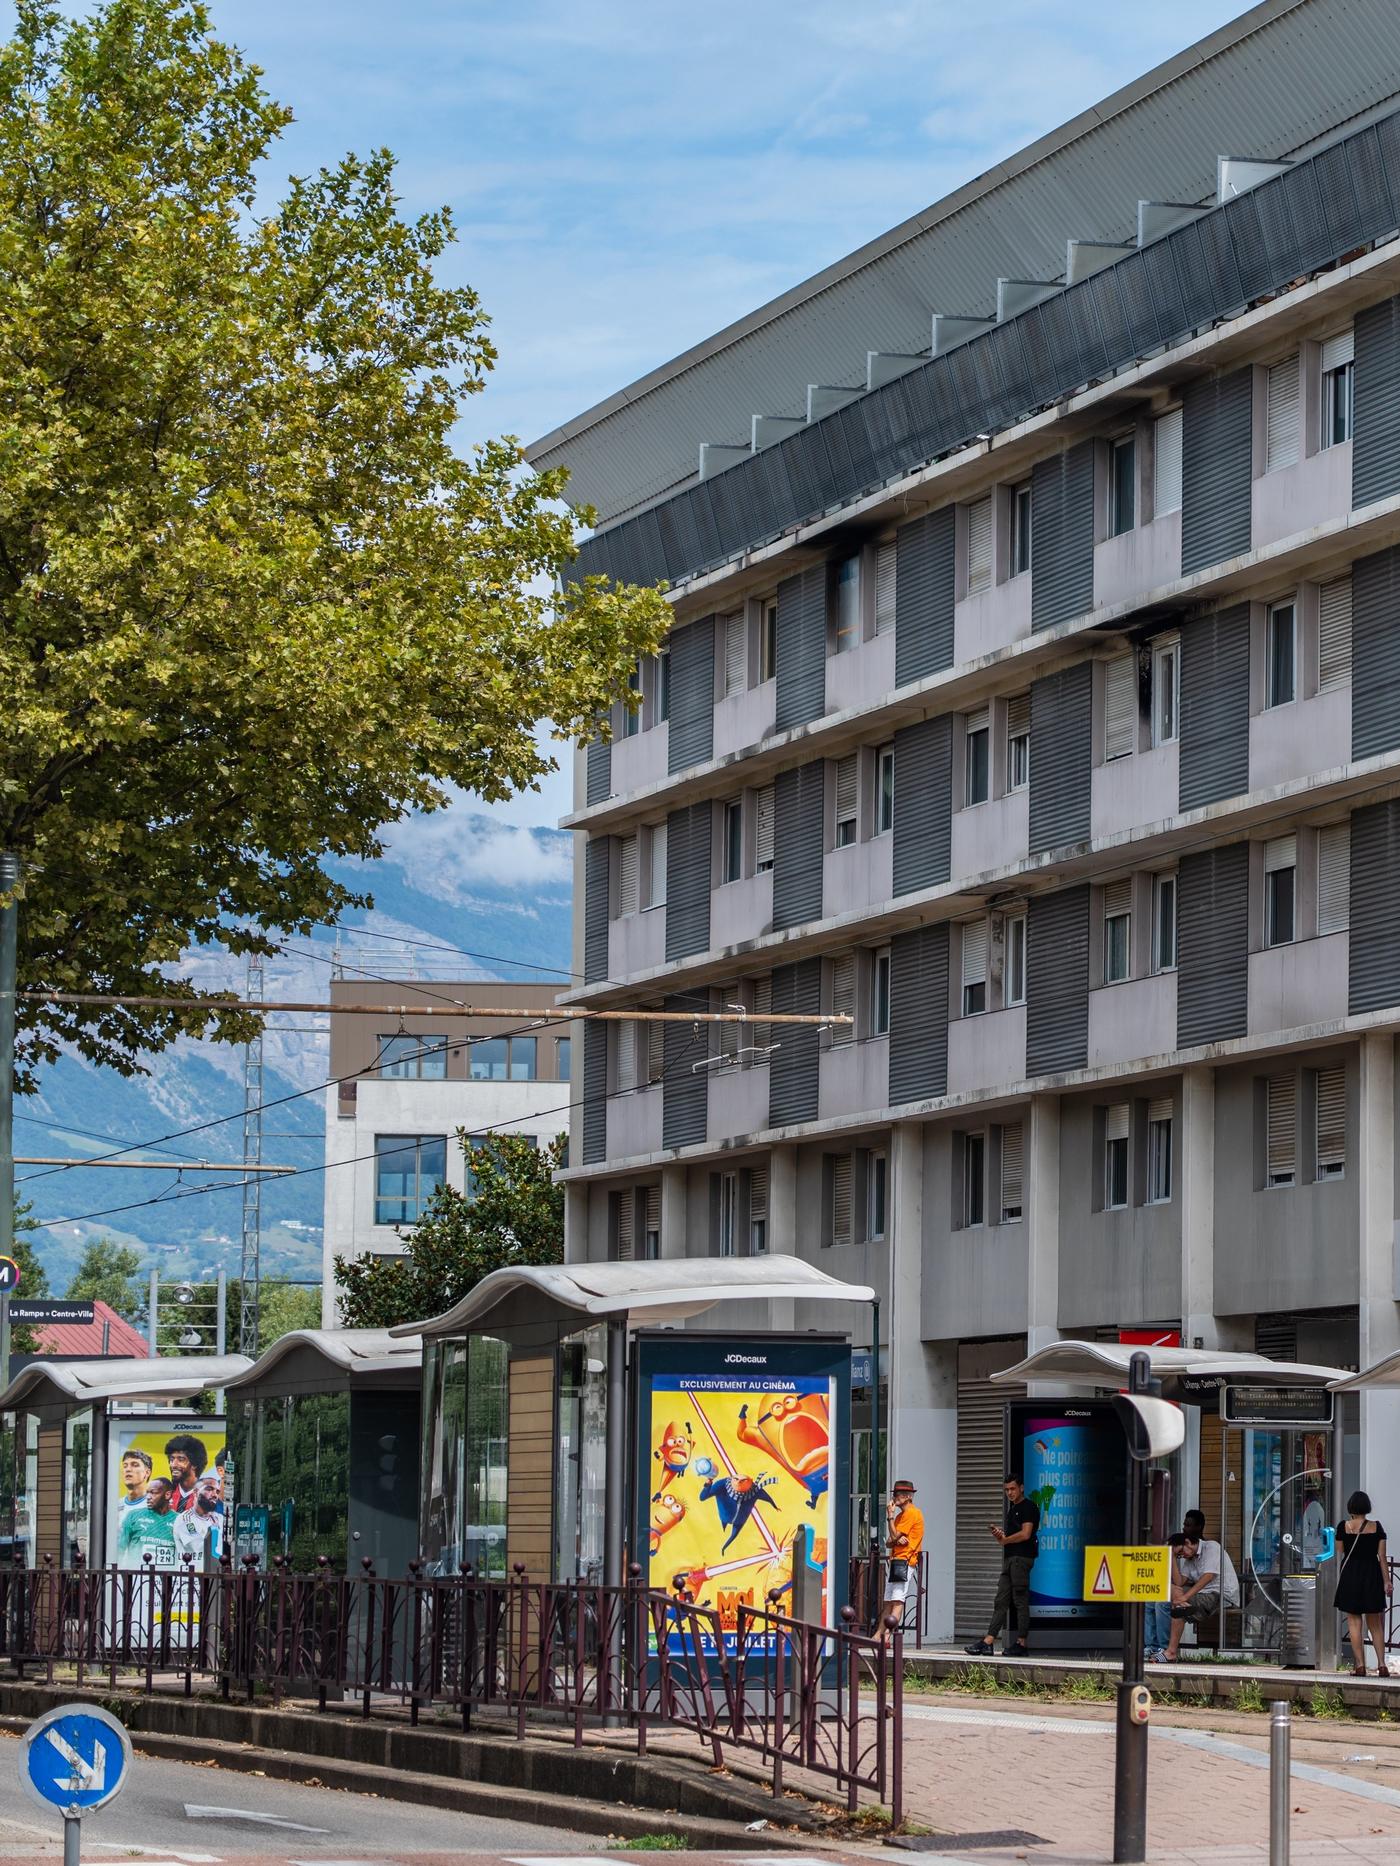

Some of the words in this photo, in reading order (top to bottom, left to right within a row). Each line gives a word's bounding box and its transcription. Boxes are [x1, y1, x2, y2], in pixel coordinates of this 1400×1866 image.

[9, 1309, 18, 1317] La
[19, 1309, 44, 1318] Rampe
[51, 1310, 93, 1318] Centre-Ville
[724, 1354, 767, 1364] JCDecaux
[679, 1380, 747, 1389] EXCLUSIVEMENT
[748, 1381, 761, 1390] AU
[762, 1380, 796, 1390] CINÉMA
[1042, 1449, 1055, 1465] Ne
[1039, 1471, 1060, 1488] plus
[1062, 1474, 1075, 1486] en
[1040, 1537, 1058, 1551] sur
[1131, 1552, 1162, 1562] ABSENCE
[1137, 1568, 1154, 1577] FEUX
[1130, 1584, 1160, 1594] PIETONS
